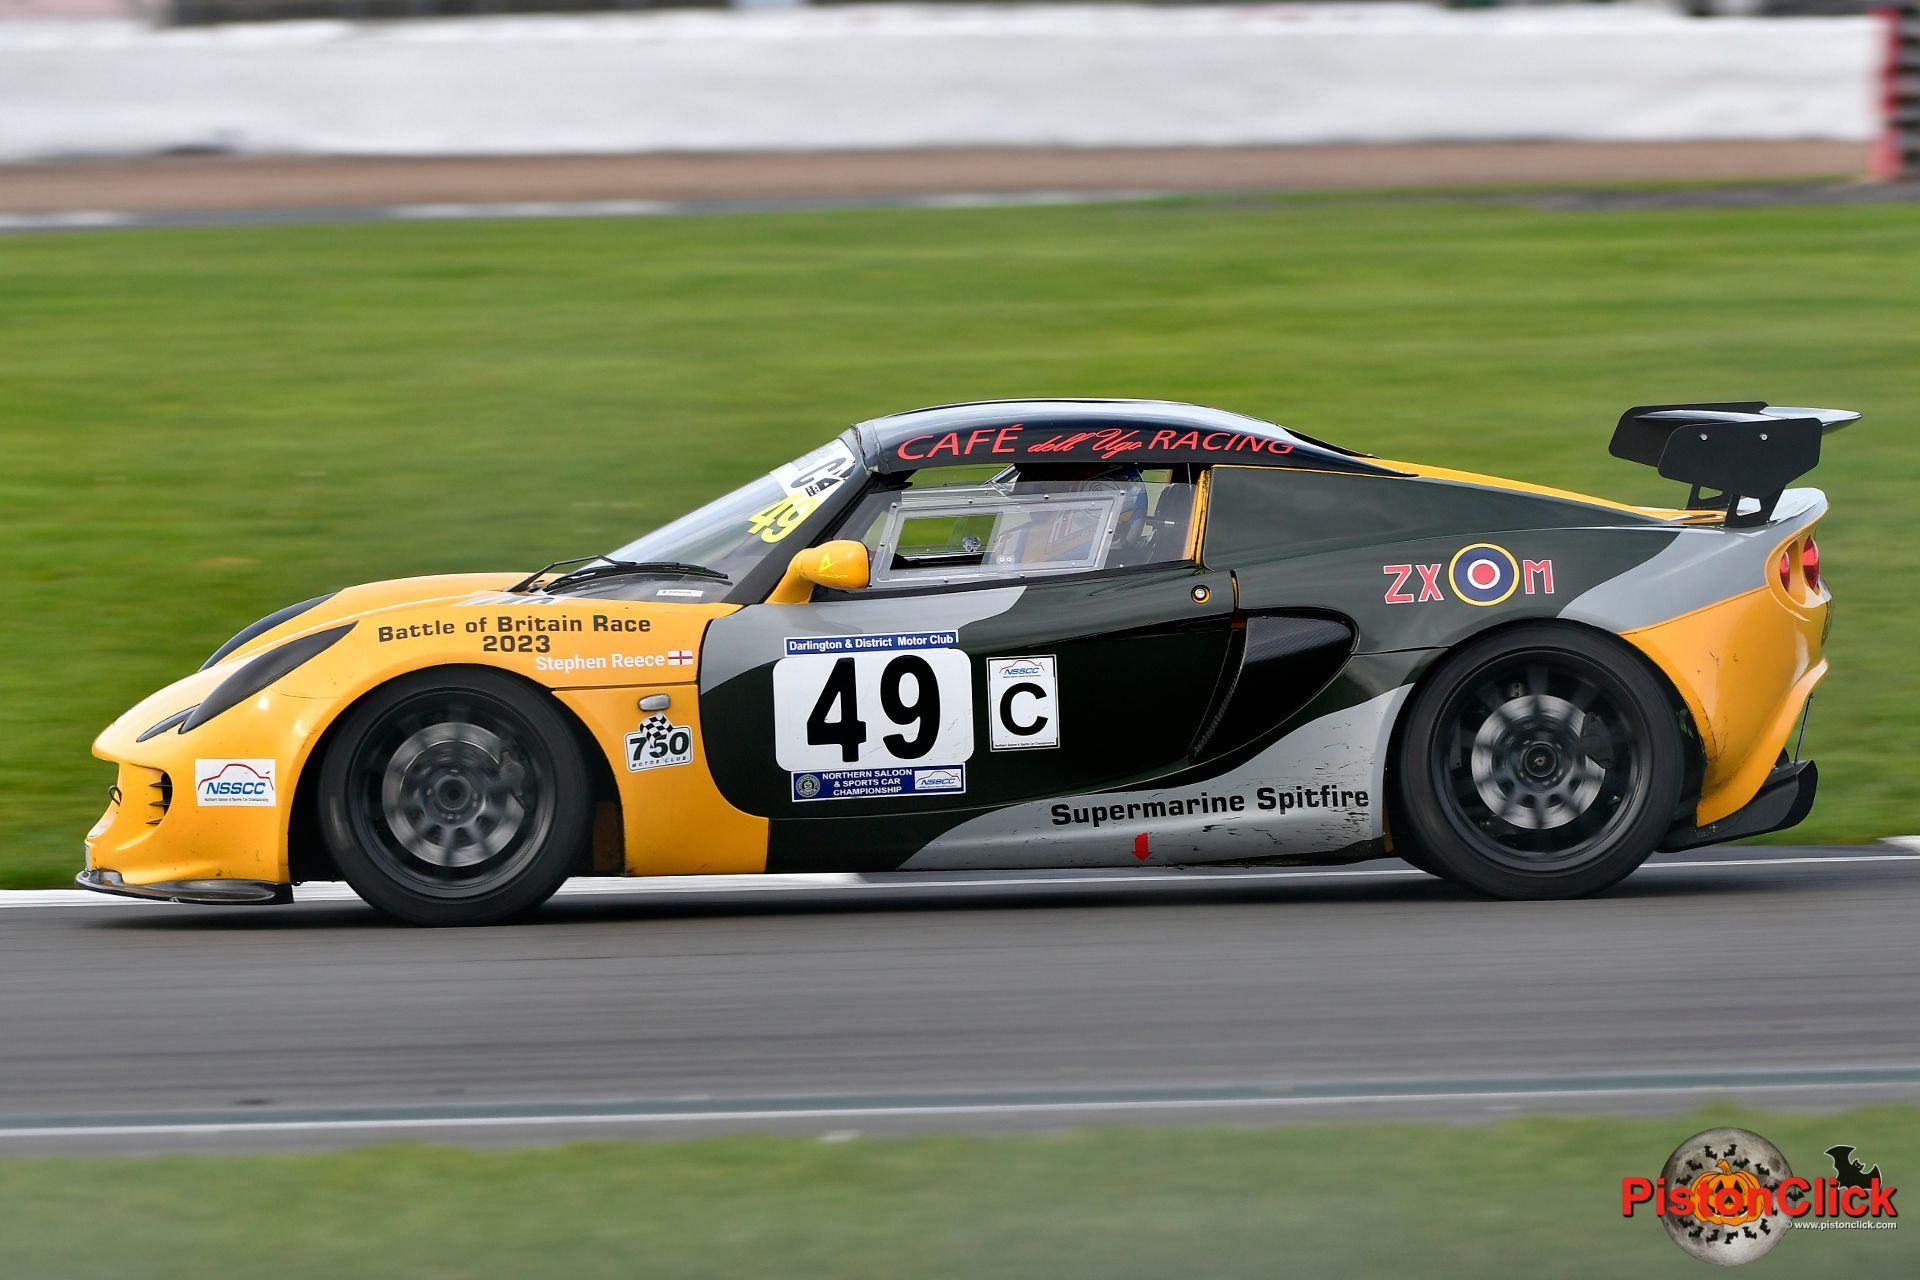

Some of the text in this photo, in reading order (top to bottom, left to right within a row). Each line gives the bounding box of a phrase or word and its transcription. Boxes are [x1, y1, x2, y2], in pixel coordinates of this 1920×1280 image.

[897, 424, 1024, 460] CAFÉ
[1091, 428, 1143, 459] Ugo
[1148, 430, 1295, 455] RACING
[747, 491, 822, 544] 49
[1383, 559, 1555, 604] ZX M
[378, 614, 651, 642] Battle of Britain Race
[482, 634, 551, 653] 2023
[789, 634, 953, 652] Darlington & District Motor Club
[535, 653, 665, 673] Stephen Reece
[807, 654, 941, 763] 49
[1000, 682, 1048, 736] C
[629, 731, 689, 761] 750
[631, 759, 660, 768] MOTOR
[822, 769, 913, 780] NORTHERN SALOON
[206, 782, 266, 795] NSSCC
[833, 778, 901, 788] & SPORTS CAR
[833, 786, 902, 796] CHAMPIONSHIP
[1051, 785, 1369, 828] Supermarine Spitfire
